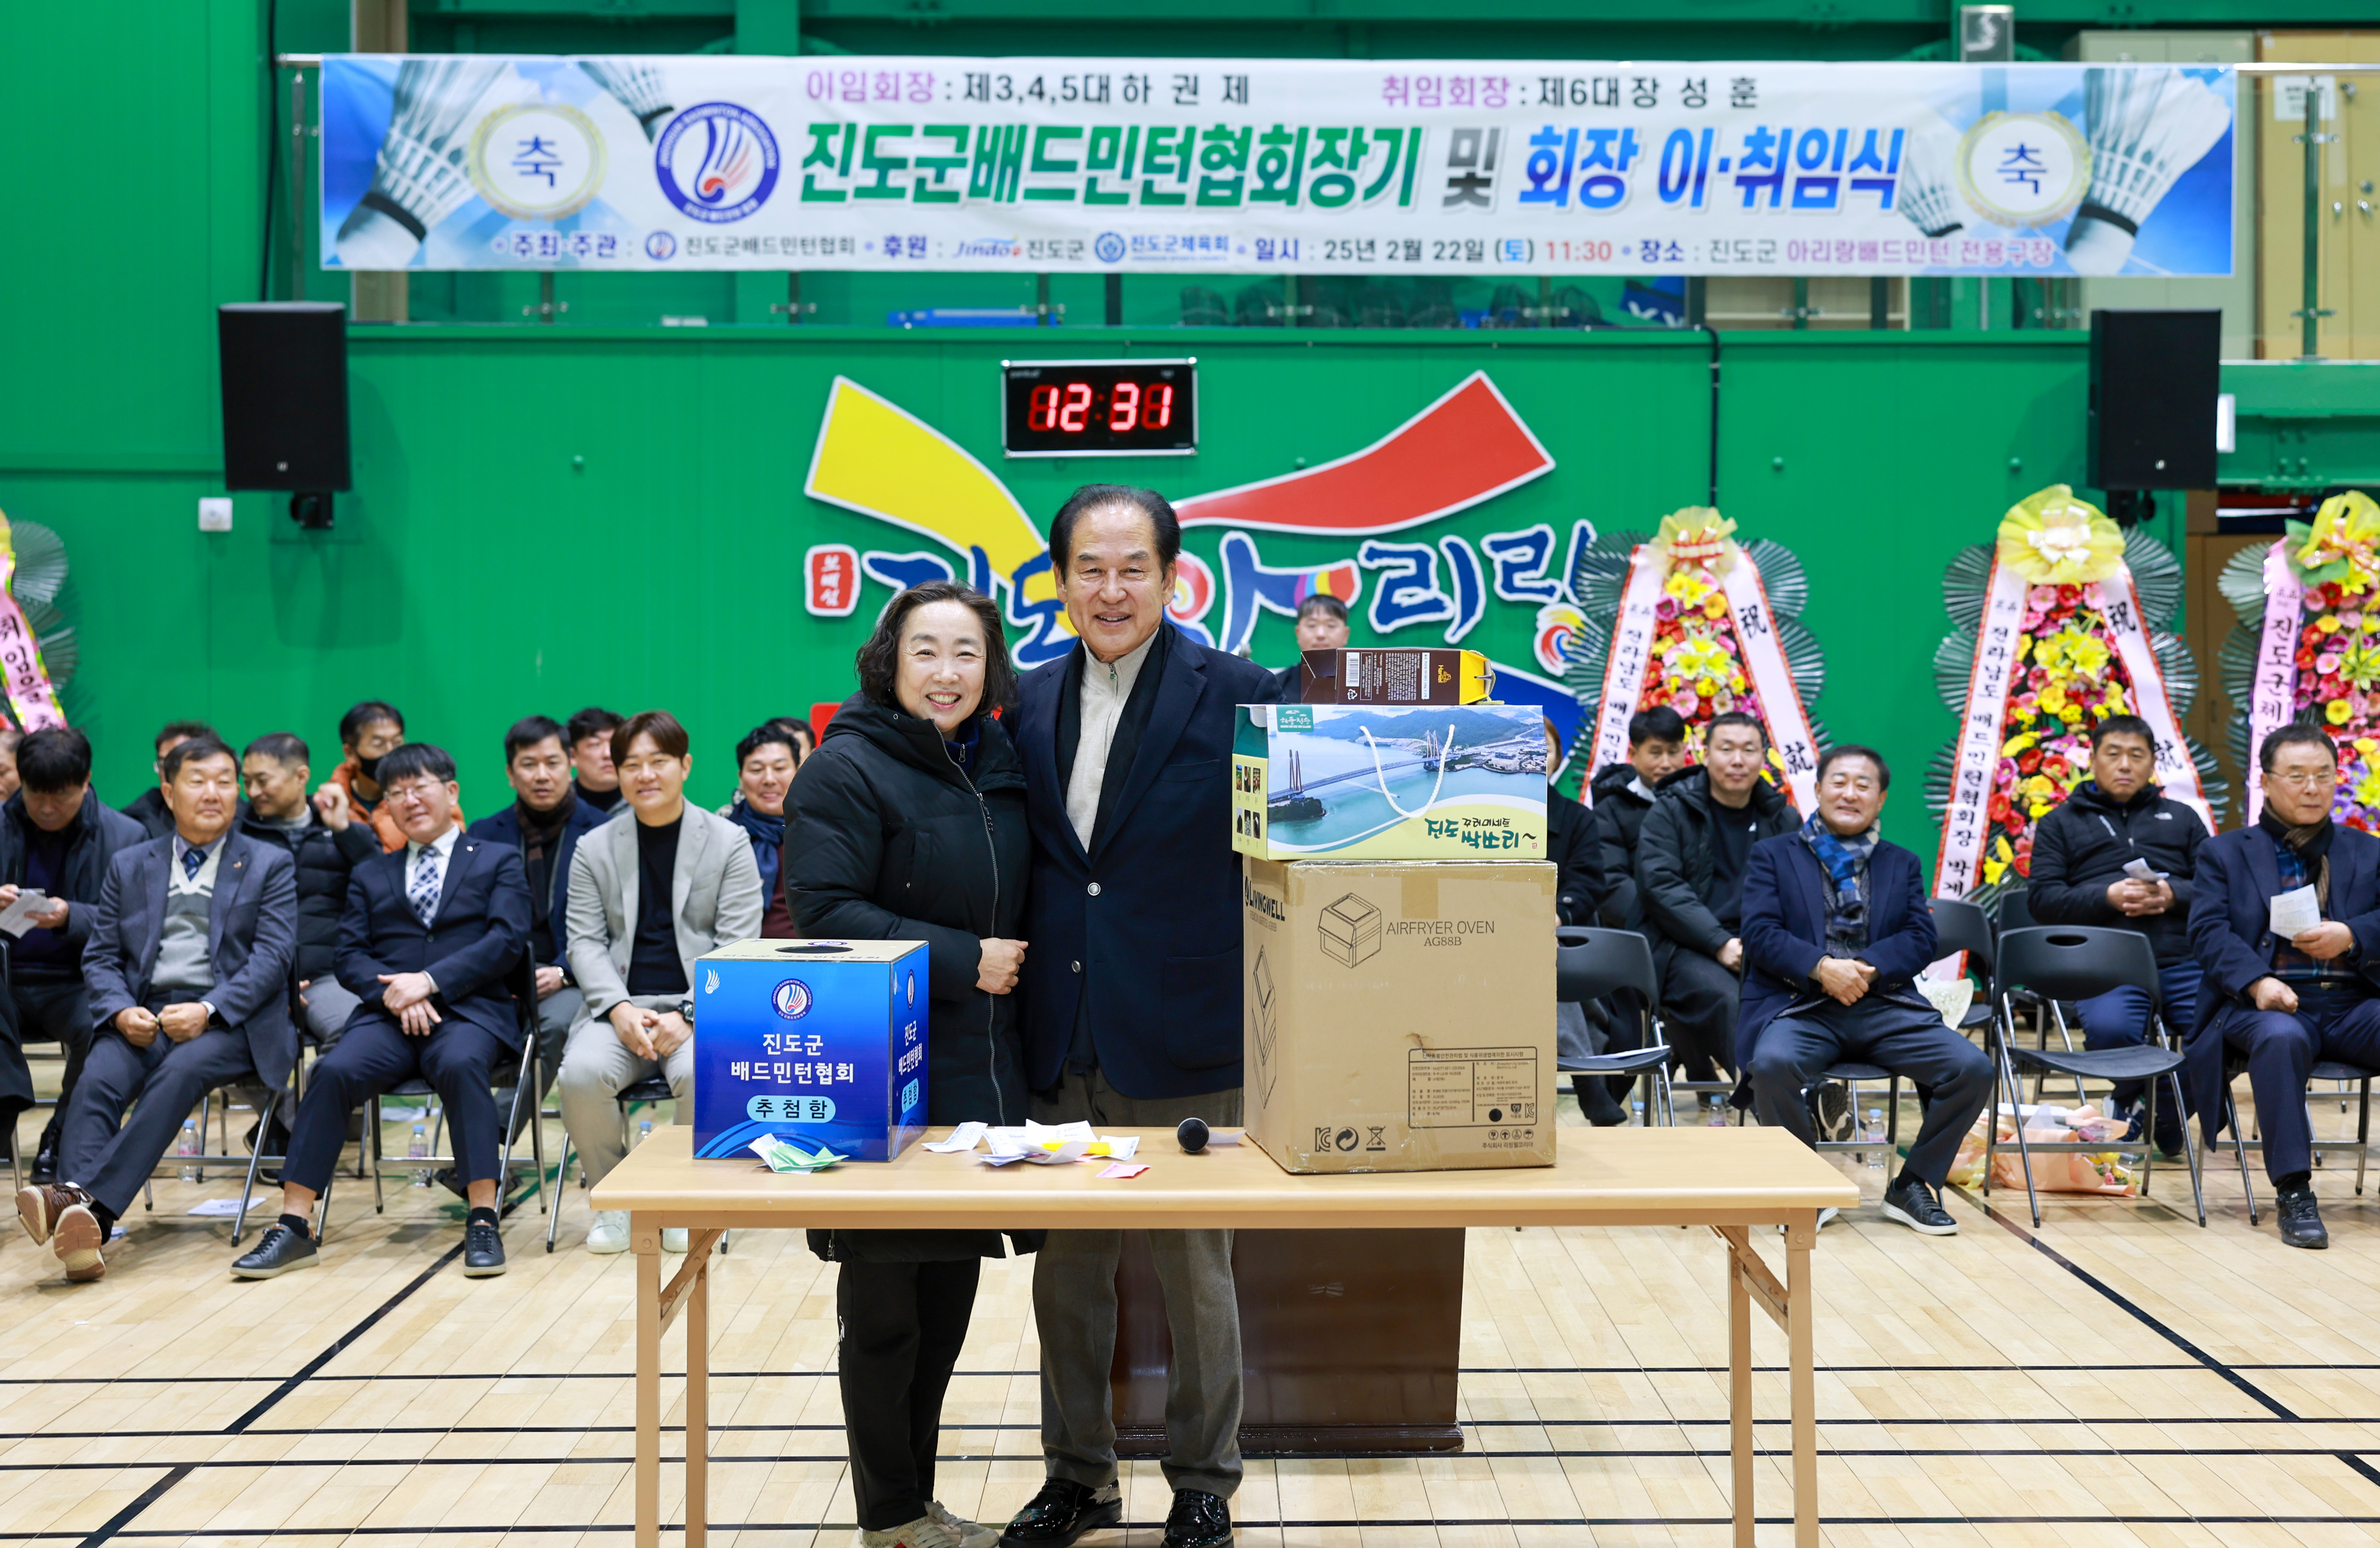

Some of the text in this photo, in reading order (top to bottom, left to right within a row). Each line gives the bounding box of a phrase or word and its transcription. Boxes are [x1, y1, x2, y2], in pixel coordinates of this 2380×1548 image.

[807, 70, 936, 102] 이임회장
[1382, 75, 1511, 107] 취임회장
[512, 136, 562, 187] 축
[800, 123, 1422, 208] 진도군배드민턴협회장기
[1441, 127, 1502, 207] 및
[1518, 125, 1639, 209] 회장
[1996, 143, 2048, 194] 축
[883, 236, 927, 259] 후원
[1026, 239, 1085, 260] 진도군
[1256, 238, 1299, 262] 일시
[1324, 240, 1376, 262] 25년
[1387, 240, 1422, 262] 2월
[1433, 240, 1484, 262] 22일
[1495, 239, 1534, 264] (토)
[1546, 241, 1613, 262] 11:30
[1639, 240, 1685, 263] 장소
[1708, 240, 1777, 263] 진도군
[1425, 818, 1459, 839] 진도
[1249, 880, 1285, 922] LIVINGWELL
[1386, 921, 1495, 935] AIRFRYER OVEN
[1423, 937, 1462, 947] AG88B
[800, 983, 812, 1005] ASSOCIATION
[762, 1033, 824, 1056] 진도군
[904, 1020, 917, 1047] 진도군
[731, 1061, 854, 1085] 배드민턴협회
[898, 1042, 923, 1076] 배드민턴협회
